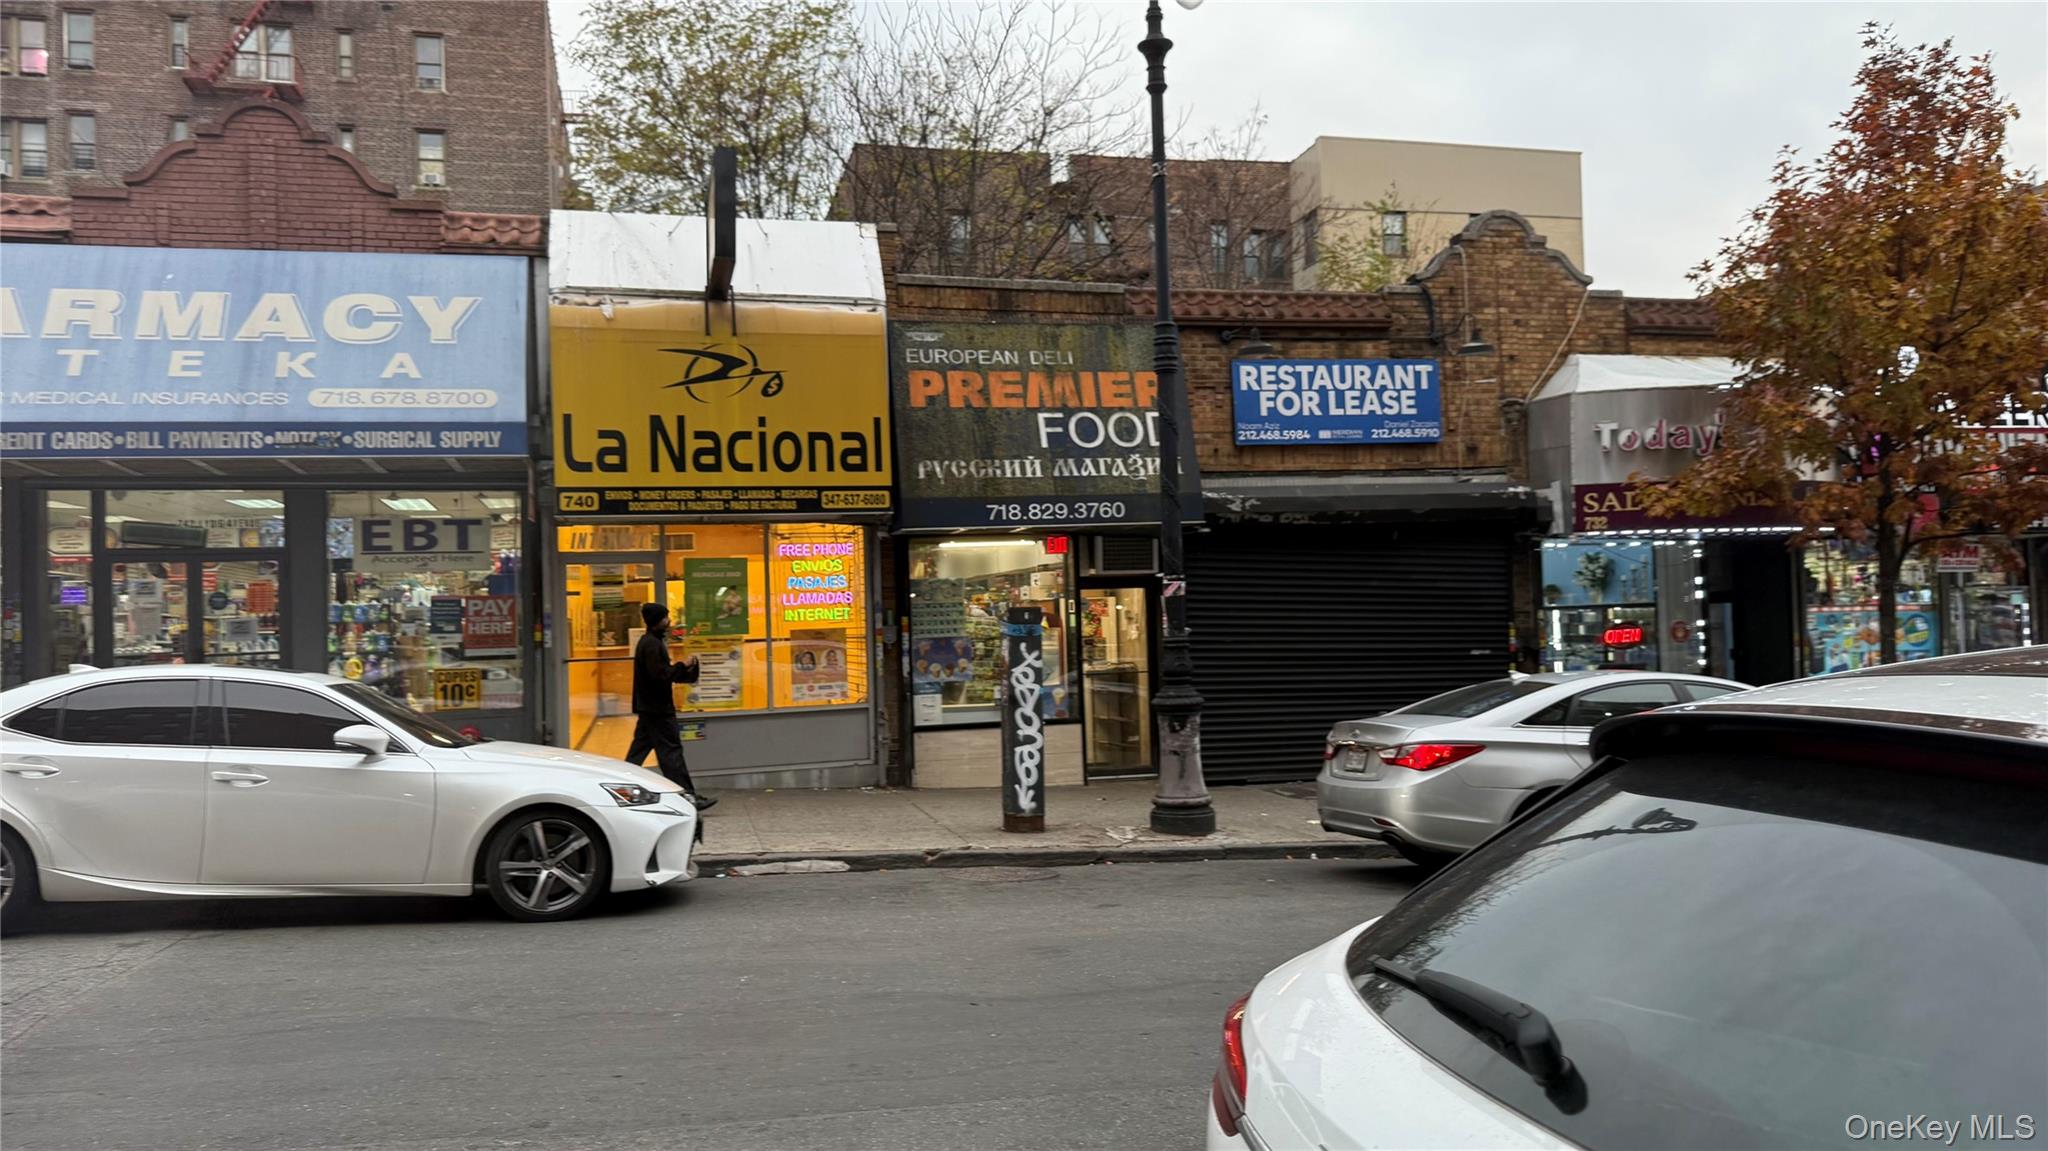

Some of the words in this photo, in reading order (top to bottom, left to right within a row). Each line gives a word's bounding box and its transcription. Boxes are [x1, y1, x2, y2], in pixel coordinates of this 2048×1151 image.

[906, 349, 1019, 365] EUROPEAN
[1030, 350, 1073, 365] DELI
[1239, 364, 1433, 391] RESTAURANT
[11, 391, 125, 405] MEDICAL
[132, 391, 289, 406] INSURANCES
[320, 391, 487, 406] 718.678.8700
[1259, 391, 1323, 417] FOR
[1328, 390, 1418, 416] LEASE
[51, 431, 114, 450] CARDS
[125, 431, 164, 450] BILL
[168, 431, 264, 450] PAYMENTS
[353, 430, 436, 449] SURGICAL
[440, 430, 502, 449] SUPPLY
[562, 413, 628, 473] La
[649, 414, 884, 473] Nacional
[563, 495, 595, 508] 740
[985, 502, 1126, 521] 718.829.3760
[361, 518, 483, 552] EBT
[778, 543, 811, 557] FREE
[812, 543, 854, 557] PHONE
[371, 555, 435, 565] Accepted
[444, 554, 474, 564] Here
[791, 559, 843, 573] ENVIOS
[788, 575, 849, 590] PASAJES
[782, 591, 853, 606] LLAMADAS
[467, 598, 513, 617] PAY
[784, 607, 851, 622] INTERNET
[467, 622, 513, 635] HERE
[1604, 627, 1643, 644] OPEN
[438, 670, 478, 683] COPIES
